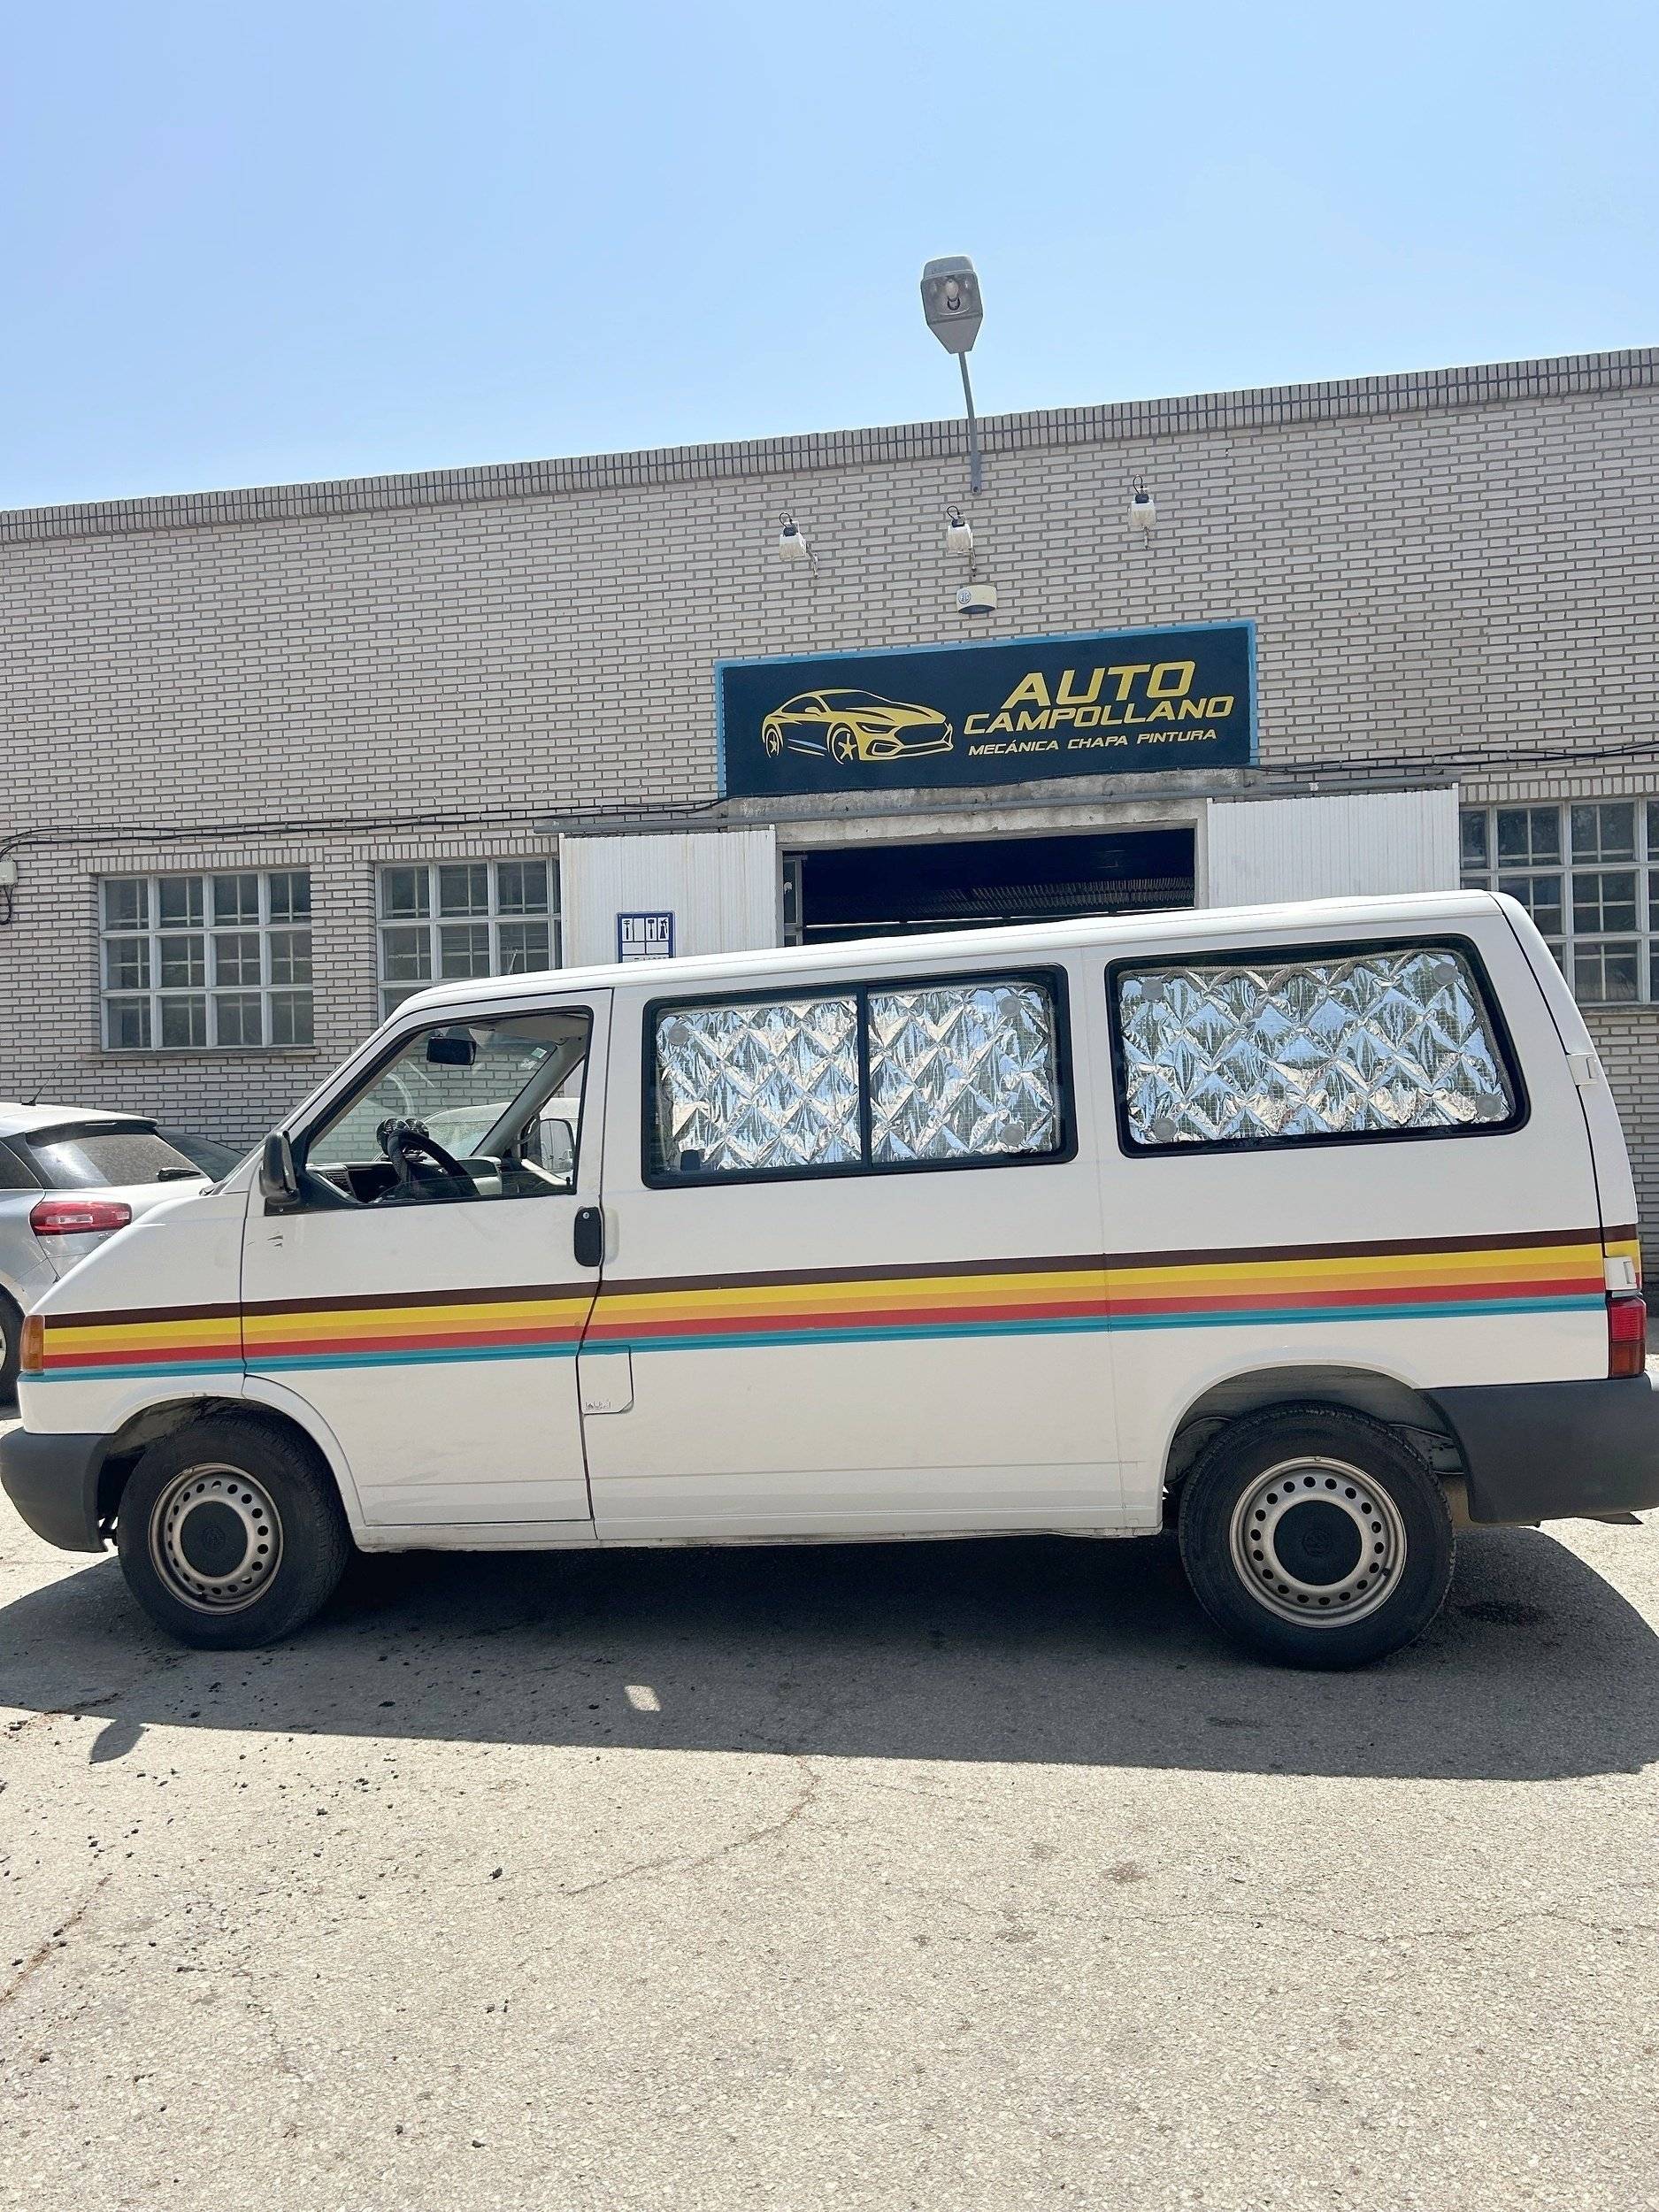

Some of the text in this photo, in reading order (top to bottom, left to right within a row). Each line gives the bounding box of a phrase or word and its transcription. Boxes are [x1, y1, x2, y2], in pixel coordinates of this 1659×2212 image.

[1001, 661, 1195, 709] AUTO
[964, 696, 1234, 734] CAMPOLLANO
[968, 729, 1217, 756] MECÁNICA CHAPA PINTURA
